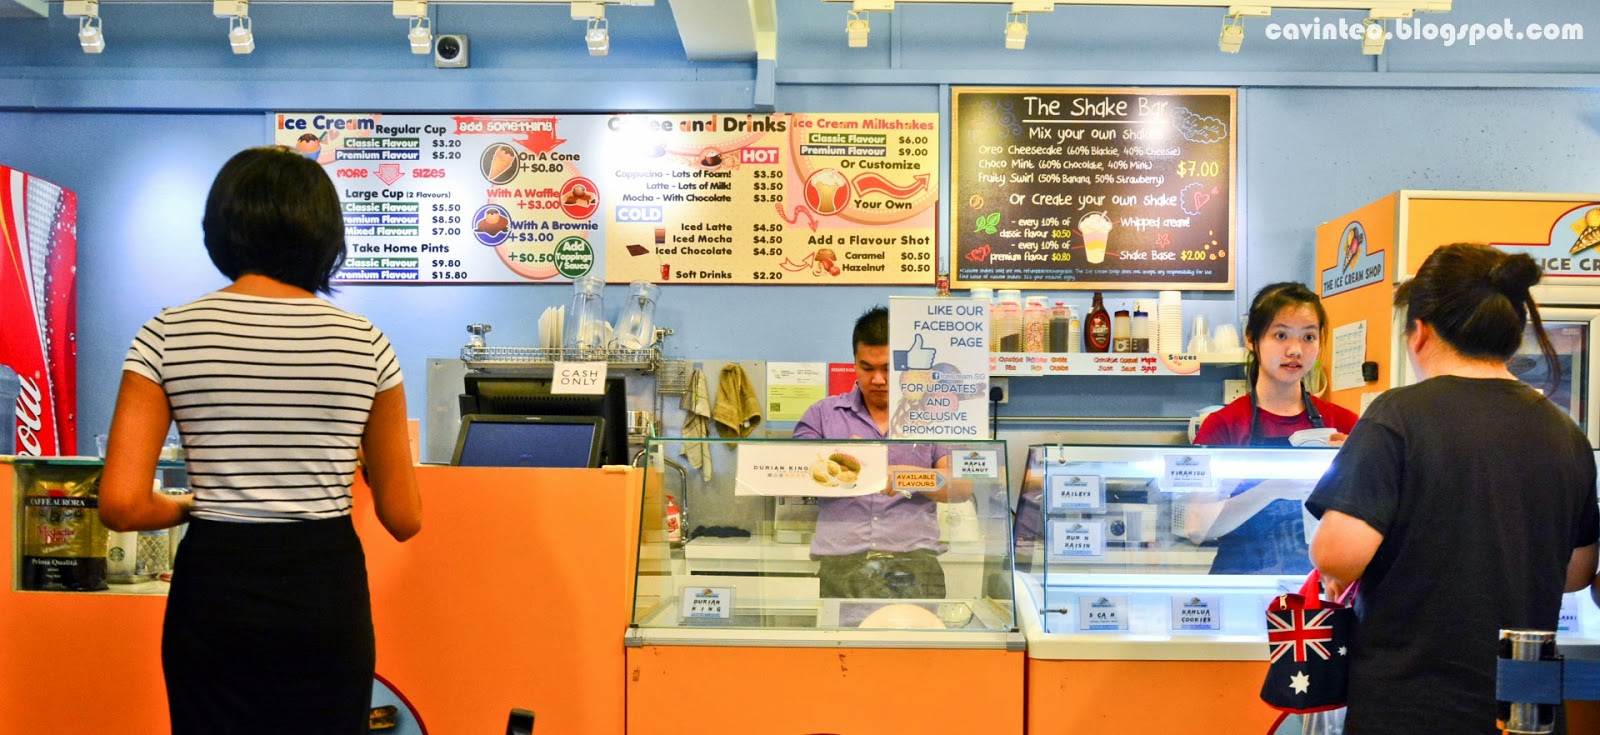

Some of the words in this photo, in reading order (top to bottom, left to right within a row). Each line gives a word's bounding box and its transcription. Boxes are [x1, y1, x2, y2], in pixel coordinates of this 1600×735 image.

[1023, 96, 1061, 116] The
[1070, 96, 1128, 117] Shake
[1138, 97, 1168, 118] Bar
[278, 115, 307, 130] Ice
[313, 115, 375, 130] Cream
[680, 115, 718, 132] and
[723, 115, 787, 132] Drinks
[793, 118, 813, 129] Ice
[817, 119, 859, 129] Cream
[862, 118, 934, 130] Milkshakes
[376, 124, 421, 136] Regular
[424, 124, 447, 136] Cup
[1029, 127, 1052, 139] Mix
[1057, 128, 1085, 144] your
[1091, 128, 1116, 140] own
[346, 137, 379, 148] Classic
[382, 137, 419, 148] Flavour
[432, 139, 462, 148] $3.20
[811, 134, 846, 144] Classic
[848, 134, 885, 144] Flavour
[898, 136, 928, 145] $6.00
[336, 150, 379, 160] Premium
[382, 150, 419, 160] Flavour
[432, 151, 462, 160] $5.20
[742, 149, 778, 163] HOT
[801, 145, 846, 156] Premium
[848, 146, 885, 157] Flavour
[898, 148, 928, 157] $9.00
[979, 146, 1003, 155] Oreo
[1008, 145, 1063, 156] Cheesecake
[1146, 147, 1181, 157] Cheesie)
[519, 152, 536, 162] On
[551, 152, 580, 162] Cone
[840, 159, 854, 169] Or
[858, 159, 921, 170] Customize
[978, 159, 1007, 169] Choco
[1011, 159, 1035, 169] Mint
[1130, 160, 1153, 170] Mint)
[1176, 160, 1219, 178] $7.00
[672, 170, 691, 178] Lots
[703, 170, 732, 178] Foam!
[753, 170, 783, 179] $3.50
[978, 172, 1006, 187] Fruity
[1010, 172, 1034, 183] Swirl
[1117, 174, 1165, 187] Strawberry)
[646, 182, 669, 190] Latte
[678, 182, 696, 190] Lots
[710, 182, 732, 190] Milk!
[753, 182, 783, 191] $3.50
[345, 189, 378, 200] Large
[382, 189, 404, 200] Cup
[416, 191, 451, 199] Flavours)
[487, 188, 512, 199] With
[525, 188, 560, 199] Waffle
[622, 194, 654, 202] Mocha
[663, 194, 684, 202] With
[686, 194, 732, 202] Chocolate
[753, 194, 783, 203] $3.50
[346, 202, 380, 212] Classic
[382, 202, 418, 212] Flavour
[432, 203, 461, 212] $5.50
[854, 199, 882, 210] Your
[885, 200, 912, 210] Own
[1009, 193, 1025, 205] Or
[1032, 193, 1073, 206] Create
[1077, 194, 1106, 210] your
[1111, 194, 1137, 206] own
[1143, 193, 1177, 206] shake
[382, 214, 418, 224] Flavour
[432, 215, 461, 224] $8.50
[617, 207, 662, 221] COLD
[511, 220, 538, 231] With
[552, 220, 598, 231] Brownie
[681, 223, 703, 231] Iced
[706, 223, 732, 231] Latte
[753, 224, 783, 232] $4.50
[1120, 216, 1160, 232] Whipped
[345, 226, 375, 236] Mixed
[377, 226, 418, 236] Flavours
[432, 227, 461, 236] $7.00
[673, 235, 695, 243] Iced
[698, 235, 732, 243] Mocha
[753, 236, 783, 244] $4.50
[808, 235, 833, 245] Add
[849, 235, 896, 245] Flavour
[901, 235, 930, 245] Shot
[352, 243, 380, 253] Take
[384, 243, 417, 253] Home
[421, 243, 450, 253] Pints
[562, 241, 585, 252] Add
[655, 246, 677, 255] Iced
[680, 246, 732, 255] Chocolate
[753, 248, 783, 256] $4.50
[555, 252, 592, 263] Toppings
[845, 251, 885, 260] Caramel
[901, 252, 930, 261] $0.50
[1119, 250, 1147, 260] Shake
[1152, 250, 1176, 260] Base:
[1180, 250, 1206, 261] $2.00
[345, 258, 380, 267] Classic
[381, 258, 418, 267] Flavour
[432, 259, 461, 267] $9.80
[563, 262, 590, 271] Sauce
[1542, 258, 1571, 271] ICE
[842, 264, 885, 272] Hazelnut
[901, 264, 930, 273] $0.50
[381, 270, 418, 279] Flavour
[432, 271, 467, 279] $15.80
[676, 271, 697, 279] Soft
[700, 271, 732, 279] Drinks
[753, 272, 783, 280] $2.20
[1323, 279, 1333, 292] THE
[1334, 276, 1343, 289] ICE
[1344, 270, 1364, 285] CREAM
[1365, 263, 1382, 279] SHOP
[927, 305, 953, 315] LIKE
[956, 305, 983, 316] OUR
[914, 320, 983, 332] FACEBOOK
[950, 337, 983, 347] PAGE
[561, 369, 598, 377] CASH
[560, 377, 597, 386] ONLY
[901, 383, 923, 392] FOR
[926, 383, 977, 393] UPDATES
[926, 398, 950, 407] AND
[909, 412, 967, 421] EXCLUSIVE
[902, 425, 977, 435] PROMOTIONS
